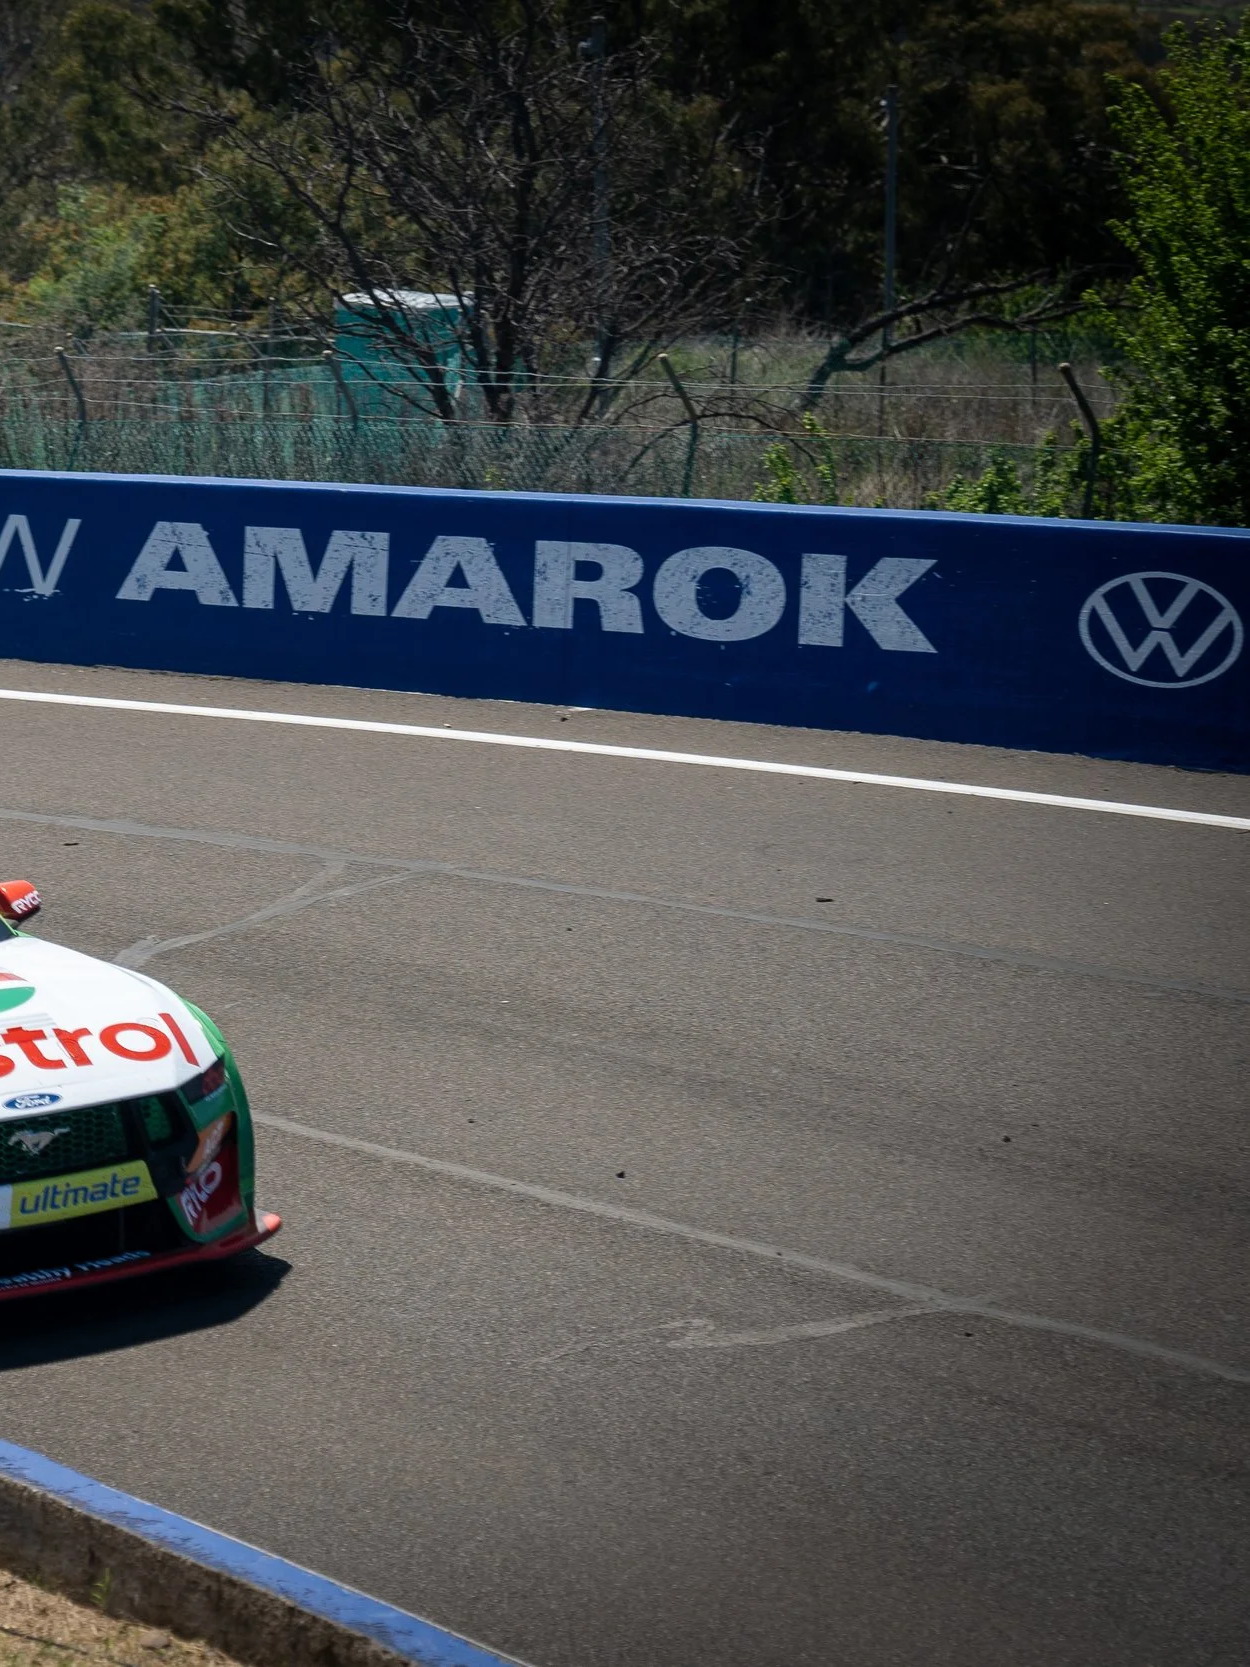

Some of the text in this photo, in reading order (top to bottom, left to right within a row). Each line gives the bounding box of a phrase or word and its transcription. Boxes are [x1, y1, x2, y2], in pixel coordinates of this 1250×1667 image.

[115, 520, 938, 654] AMAROK
[14, 1094, 51, 1109] Ford
[20, 1172, 141, 1215] ultimate
